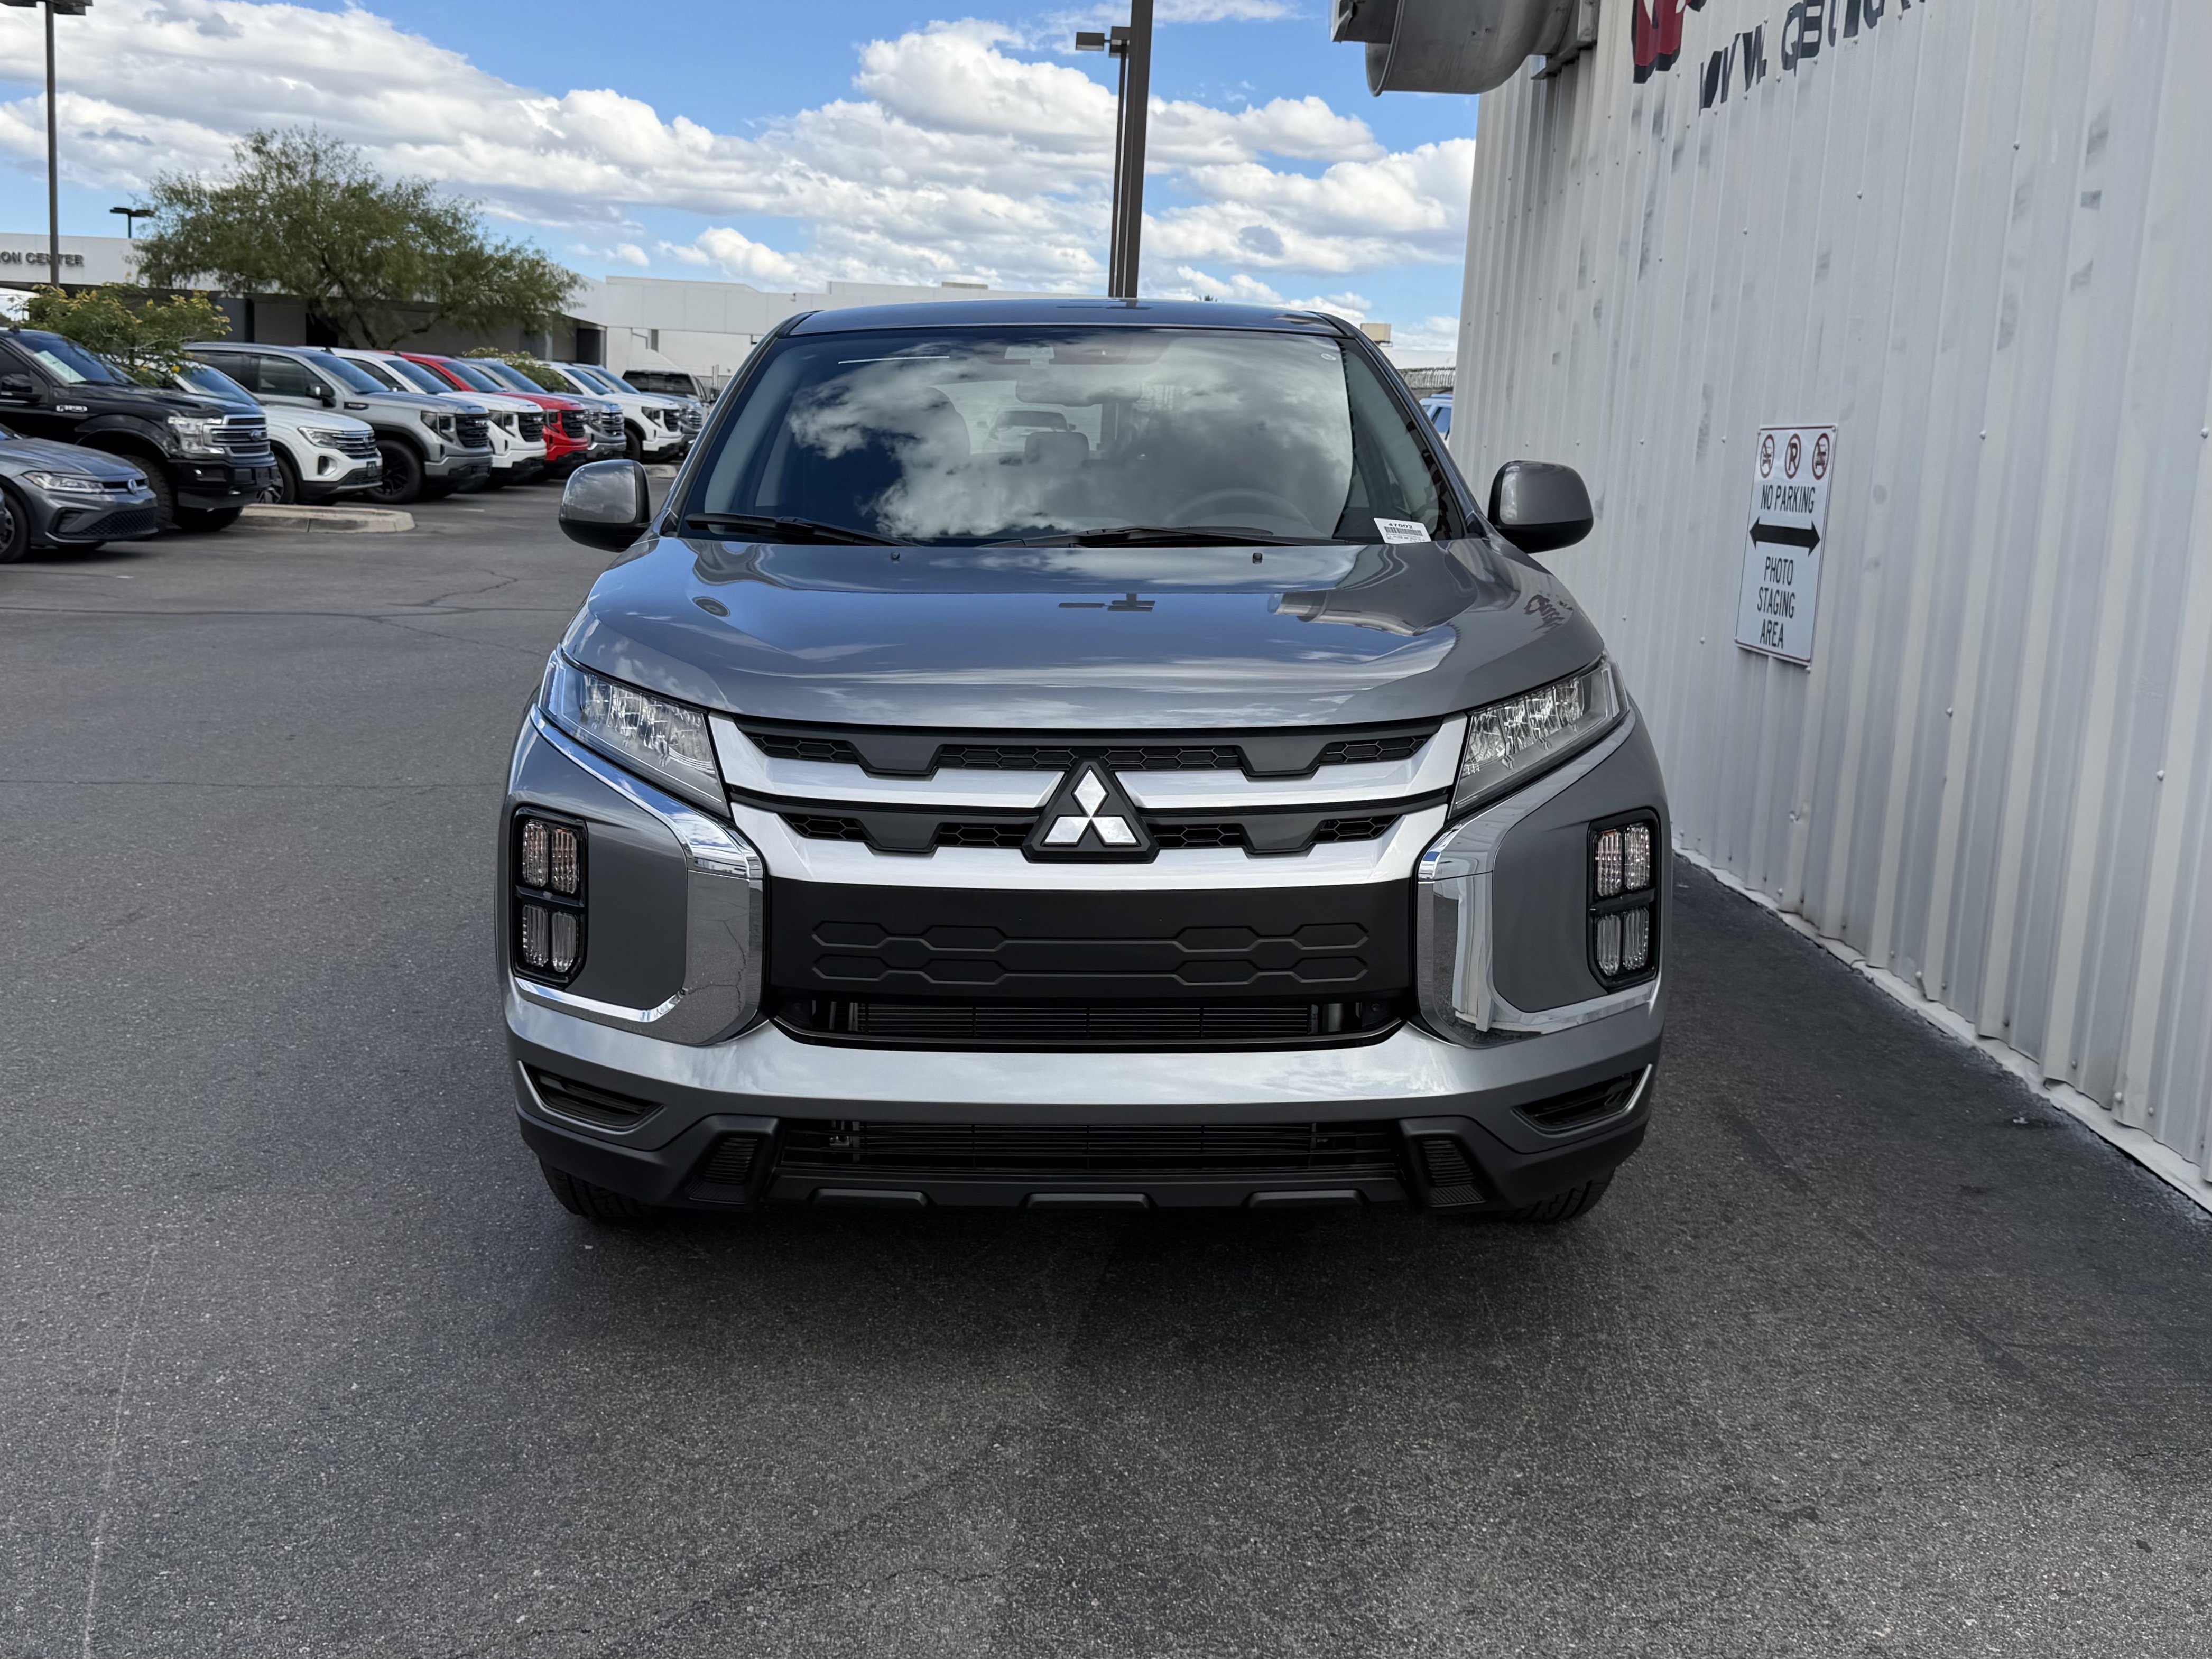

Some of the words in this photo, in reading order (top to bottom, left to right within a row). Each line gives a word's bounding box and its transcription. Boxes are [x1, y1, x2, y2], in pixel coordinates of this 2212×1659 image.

[0, 251, 21, 263] ON
[1761, 484, 1773, 510] NO
[1774, 485, 1815, 514] PARKING
[1764, 556, 1793, 586] PHOTO
[1757, 587, 1795, 618] STAGING
[1760, 619, 1783, 648] AREA
